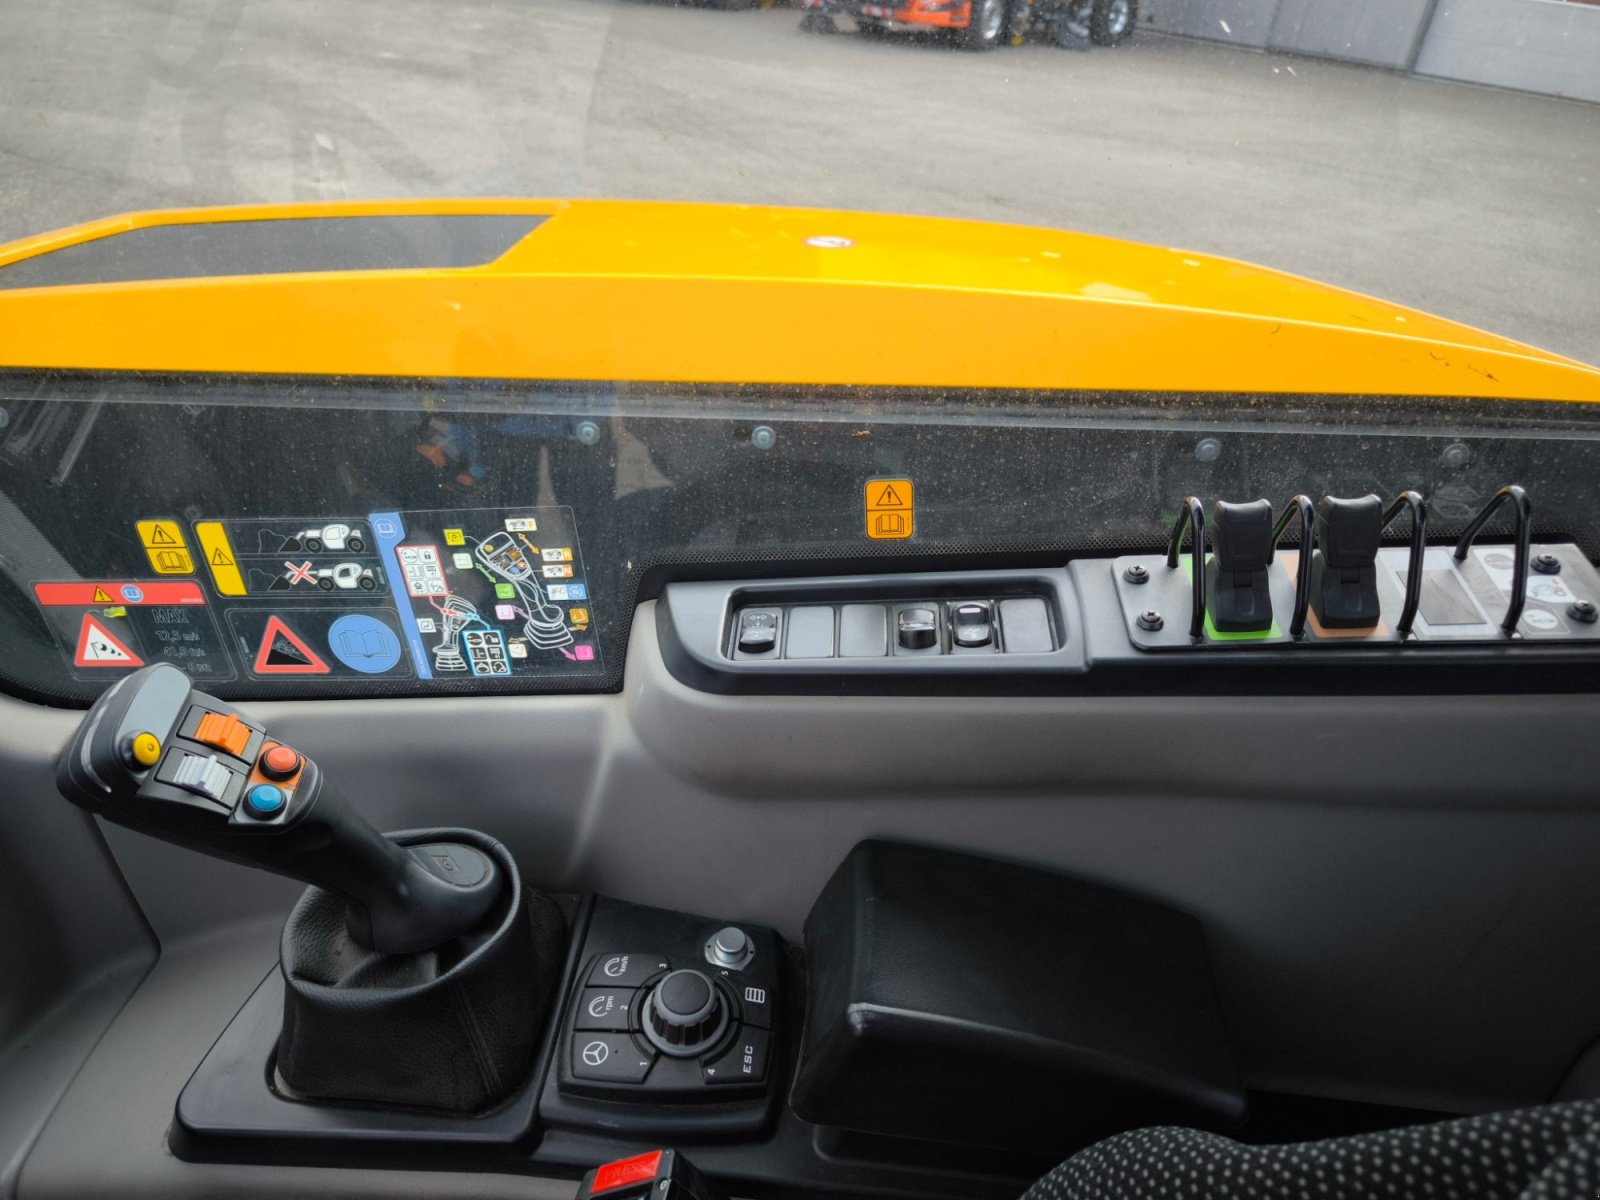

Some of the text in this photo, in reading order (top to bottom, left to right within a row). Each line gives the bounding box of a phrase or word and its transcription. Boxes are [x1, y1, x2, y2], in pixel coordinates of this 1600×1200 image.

[152, 608, 189, 623] MAX
[619, 955, 629, 972] km/h
[605, 995, 614, 1010] rpm
[742, 1045, 754, 1074] ESC
[707, 1068, 716, 1076] 4
